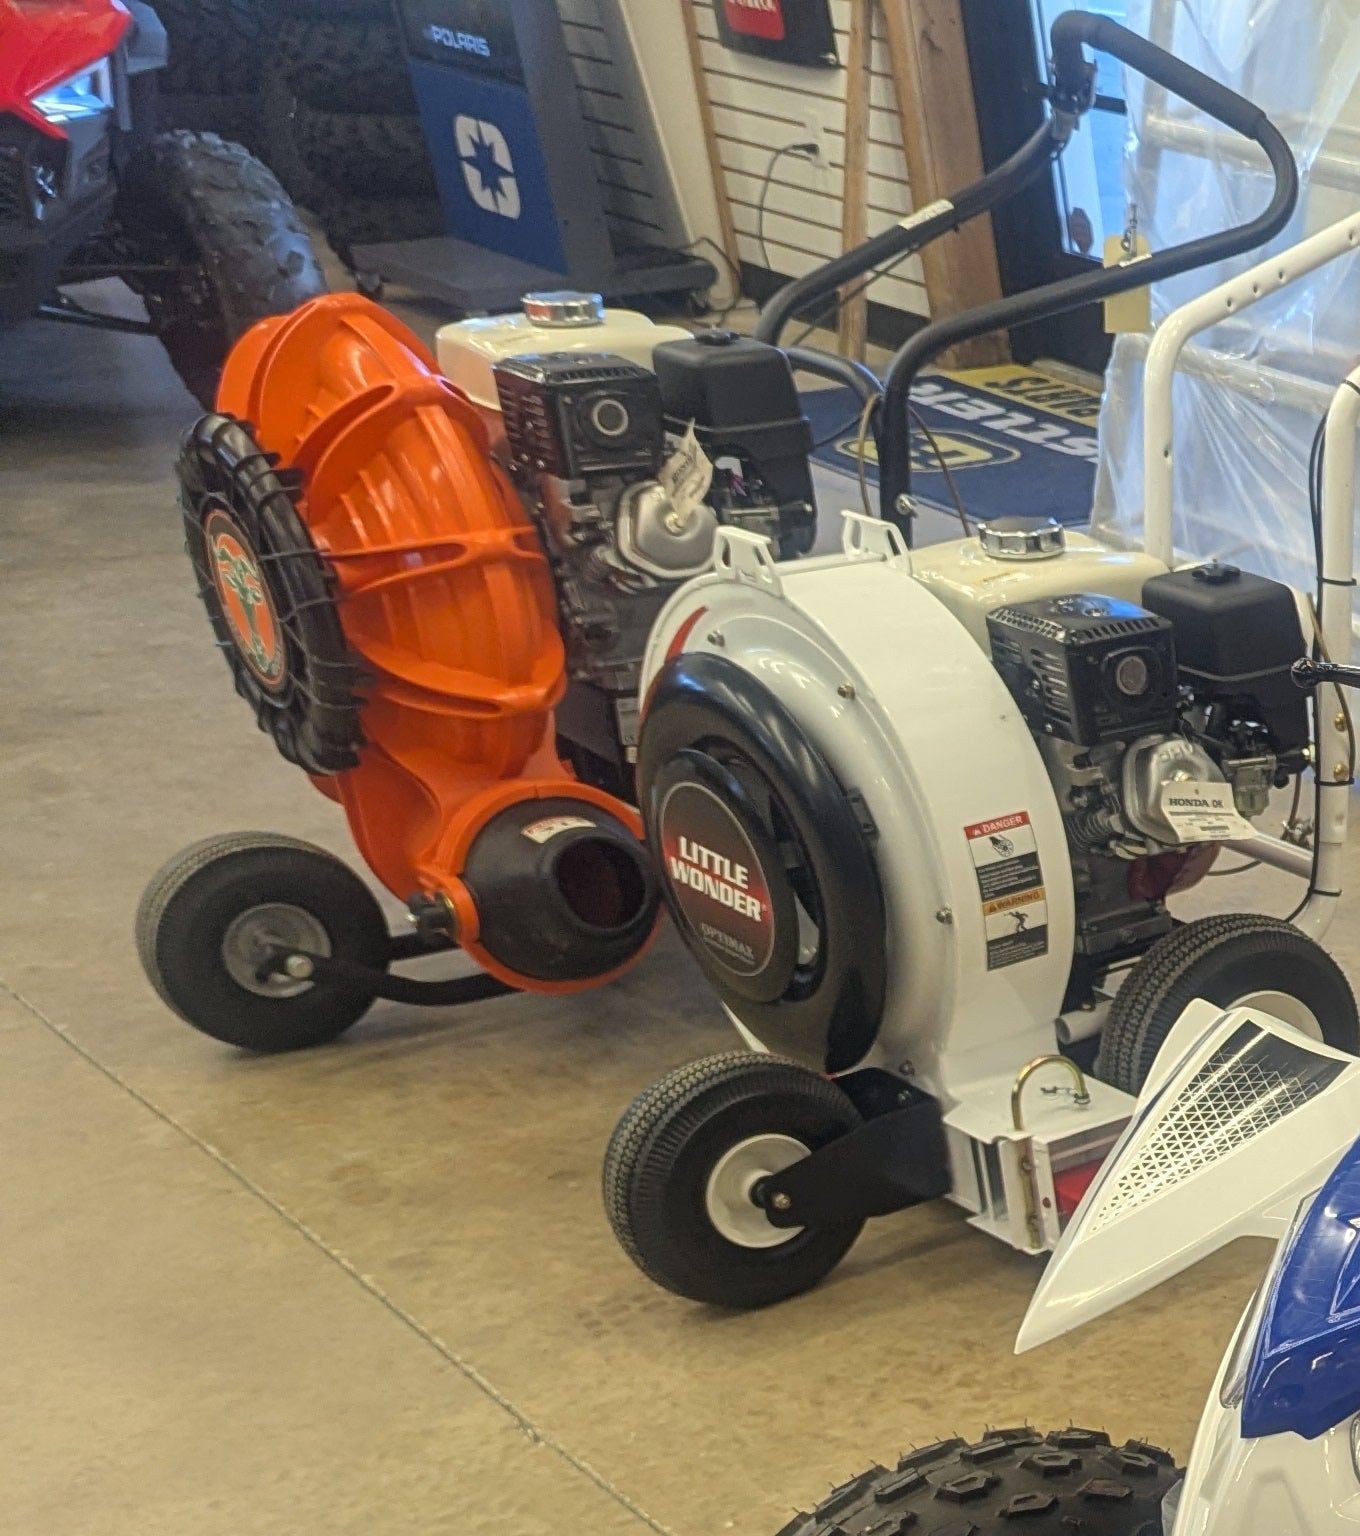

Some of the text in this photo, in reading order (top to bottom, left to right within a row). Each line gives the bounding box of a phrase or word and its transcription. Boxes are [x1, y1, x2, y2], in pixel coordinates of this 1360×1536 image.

[430, 25, 490, 57] POLARIS
[1169, 798, 1210, 808] HONDA
[982, 815, 1024, 835] DANGER
[677, 836, 749, 889] LITTLE
[669, 857, 762, 922] WONDER
[998, 891, 1041, 911] WARNING
